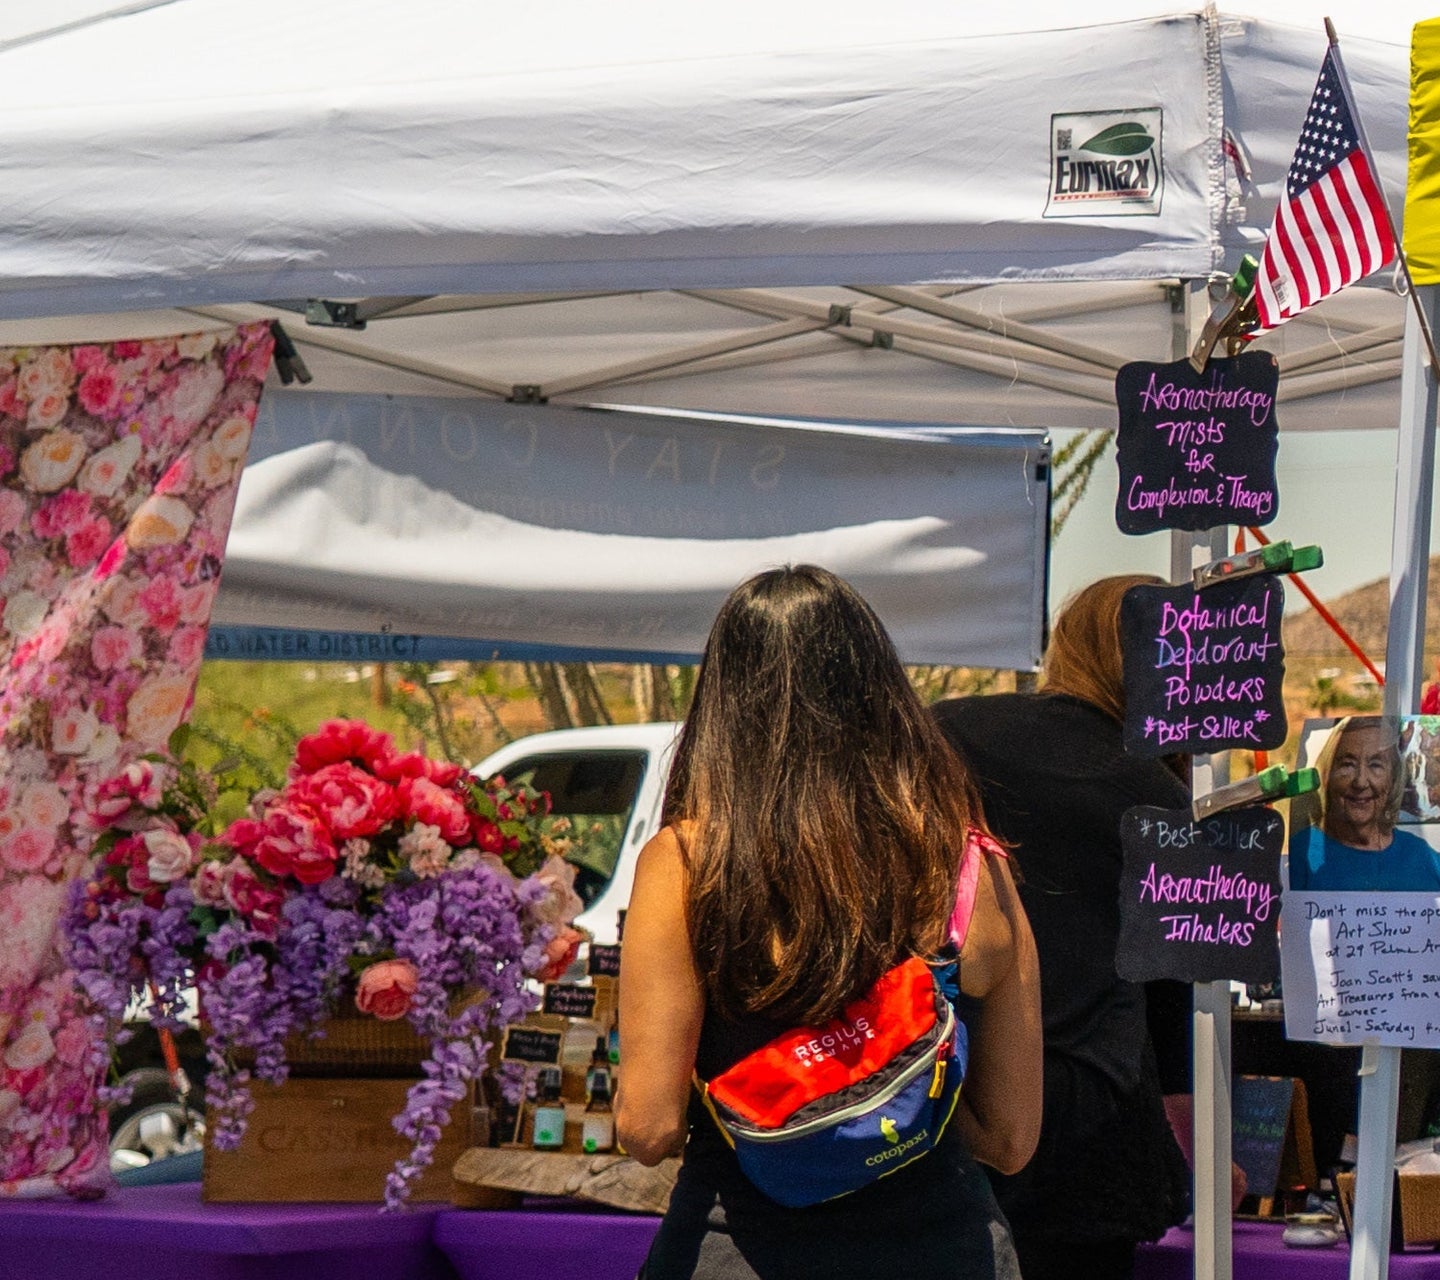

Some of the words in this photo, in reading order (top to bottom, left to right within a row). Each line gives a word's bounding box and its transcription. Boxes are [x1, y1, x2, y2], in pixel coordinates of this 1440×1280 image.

[1054, 156, 1150, 195] Eurmax
[1156, 421, 1225, 453] Mists
[1128, 476, 1211, 517] Complexion
[1226, 474, 1272, 514] Therapy
[1159, 590, 1272, 639] Botanical
[319, 634, 422, 657] DISTRICT
[1155, 634, 1278, 669] Deodorant
[1165, 677, 1266, 711] Powders
[1305, 901, 1347, 920] Don't
[1356, 903, 1387, 918] miss
[1395, 905, 1417, 918] the
[1335, 921, 1364, 940] Art
[1368, 922, 1412, 937] Show
[1330, 969, 1362, 988] Joan
[794, 1017, 870, 1061] REGIUS
[1365, 1020, 1416, 1040] Saturday
[865, 1129, 928, 1167] cotopaxi
